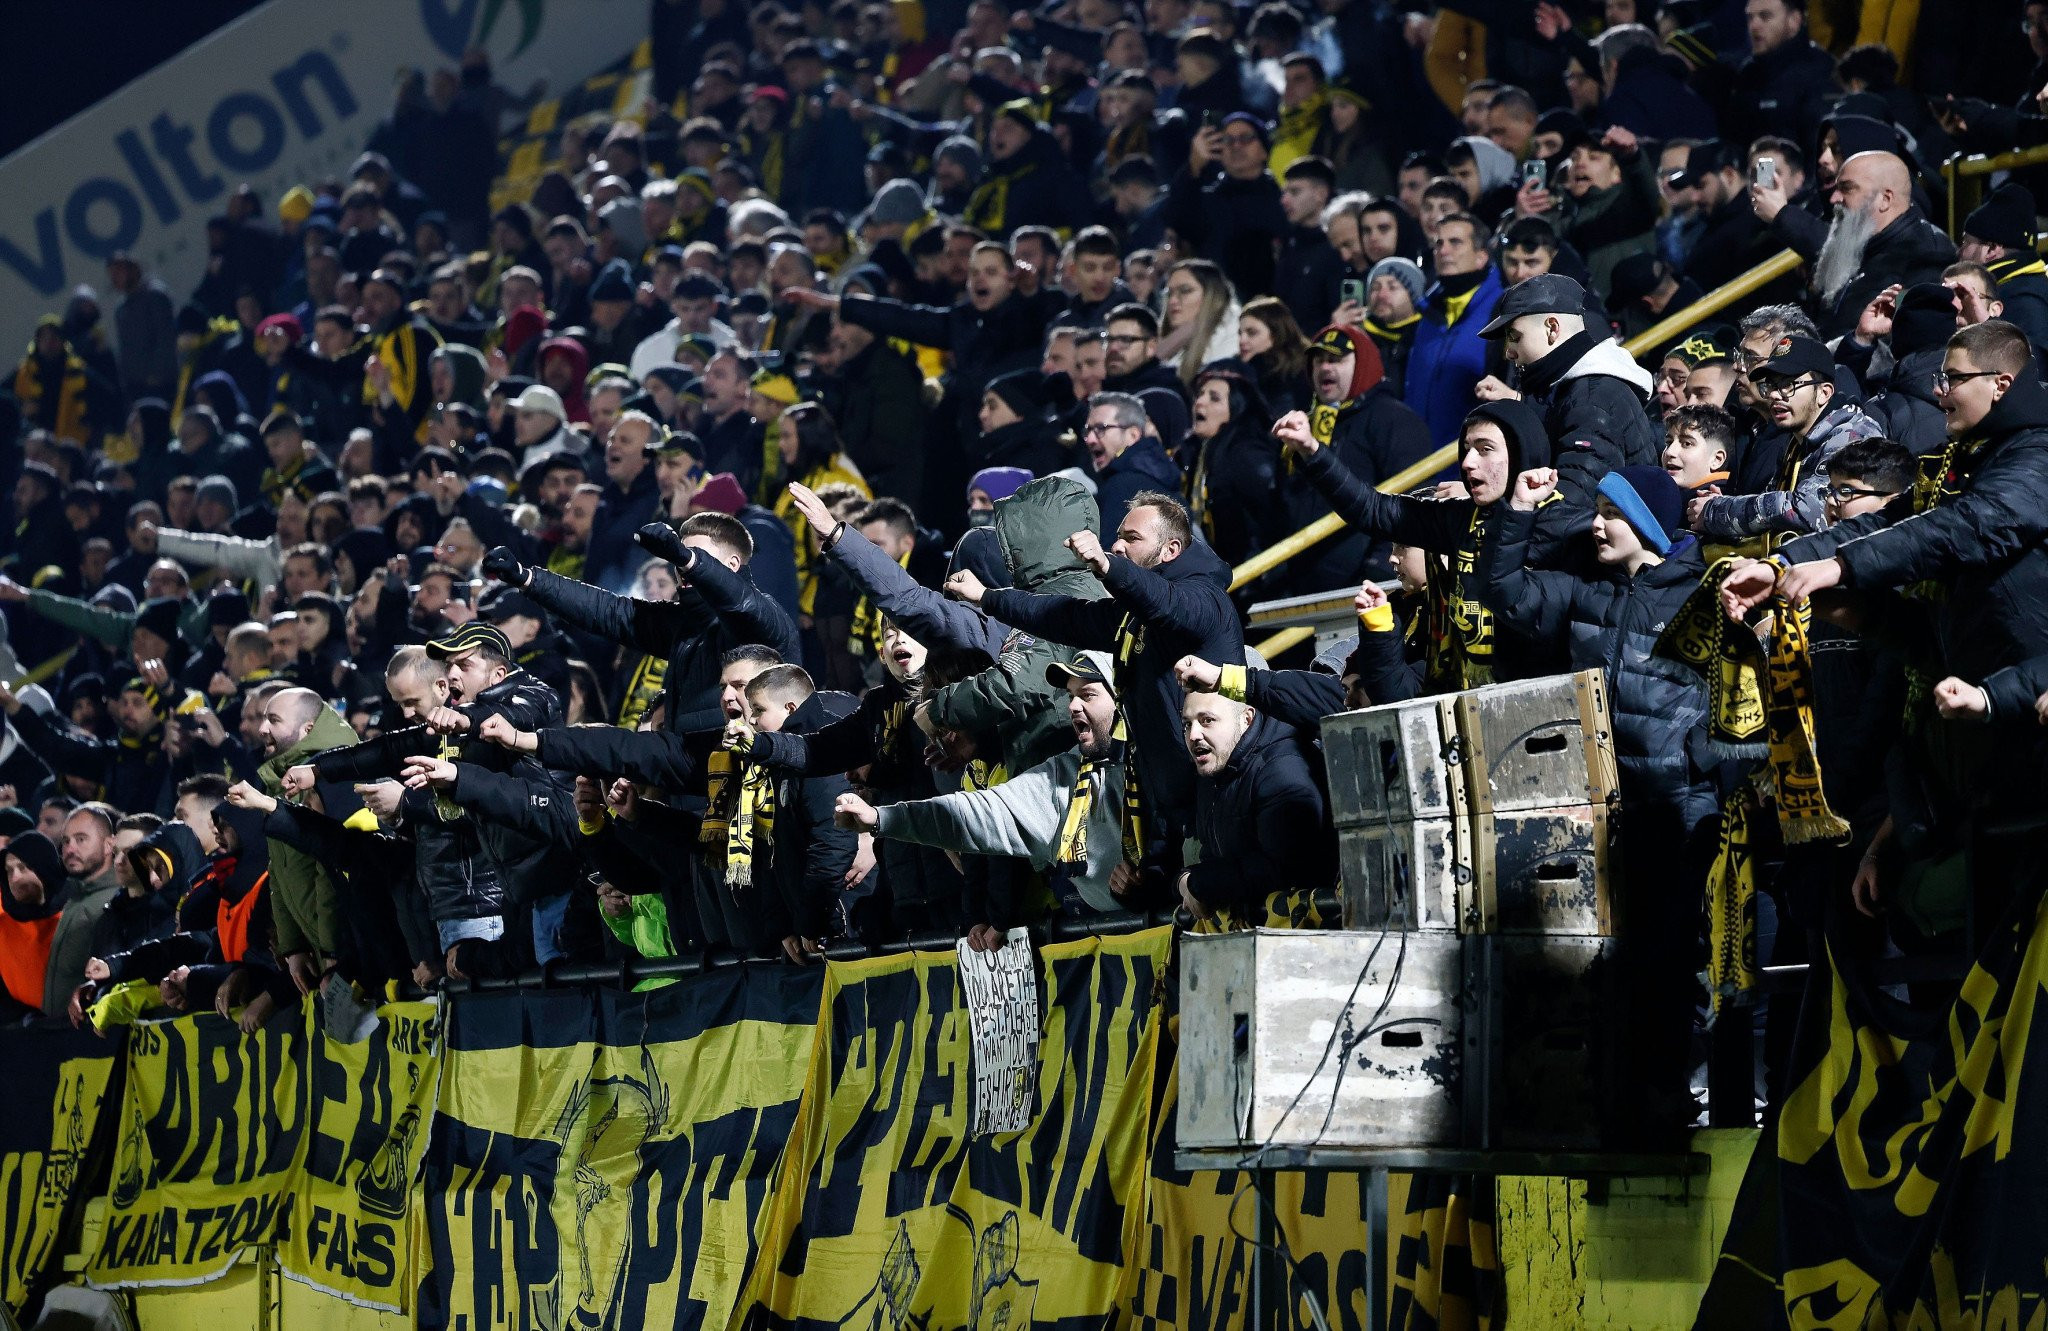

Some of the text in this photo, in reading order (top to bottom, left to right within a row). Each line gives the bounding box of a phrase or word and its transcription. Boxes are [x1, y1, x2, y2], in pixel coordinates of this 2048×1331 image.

[0, 51, 359, 296] volton
[964, 968, 1038, 1008] YOU ARE THE
[983, 1035, 1006, 1068] WANT
[307, 1205, 396, 1287] FAS
